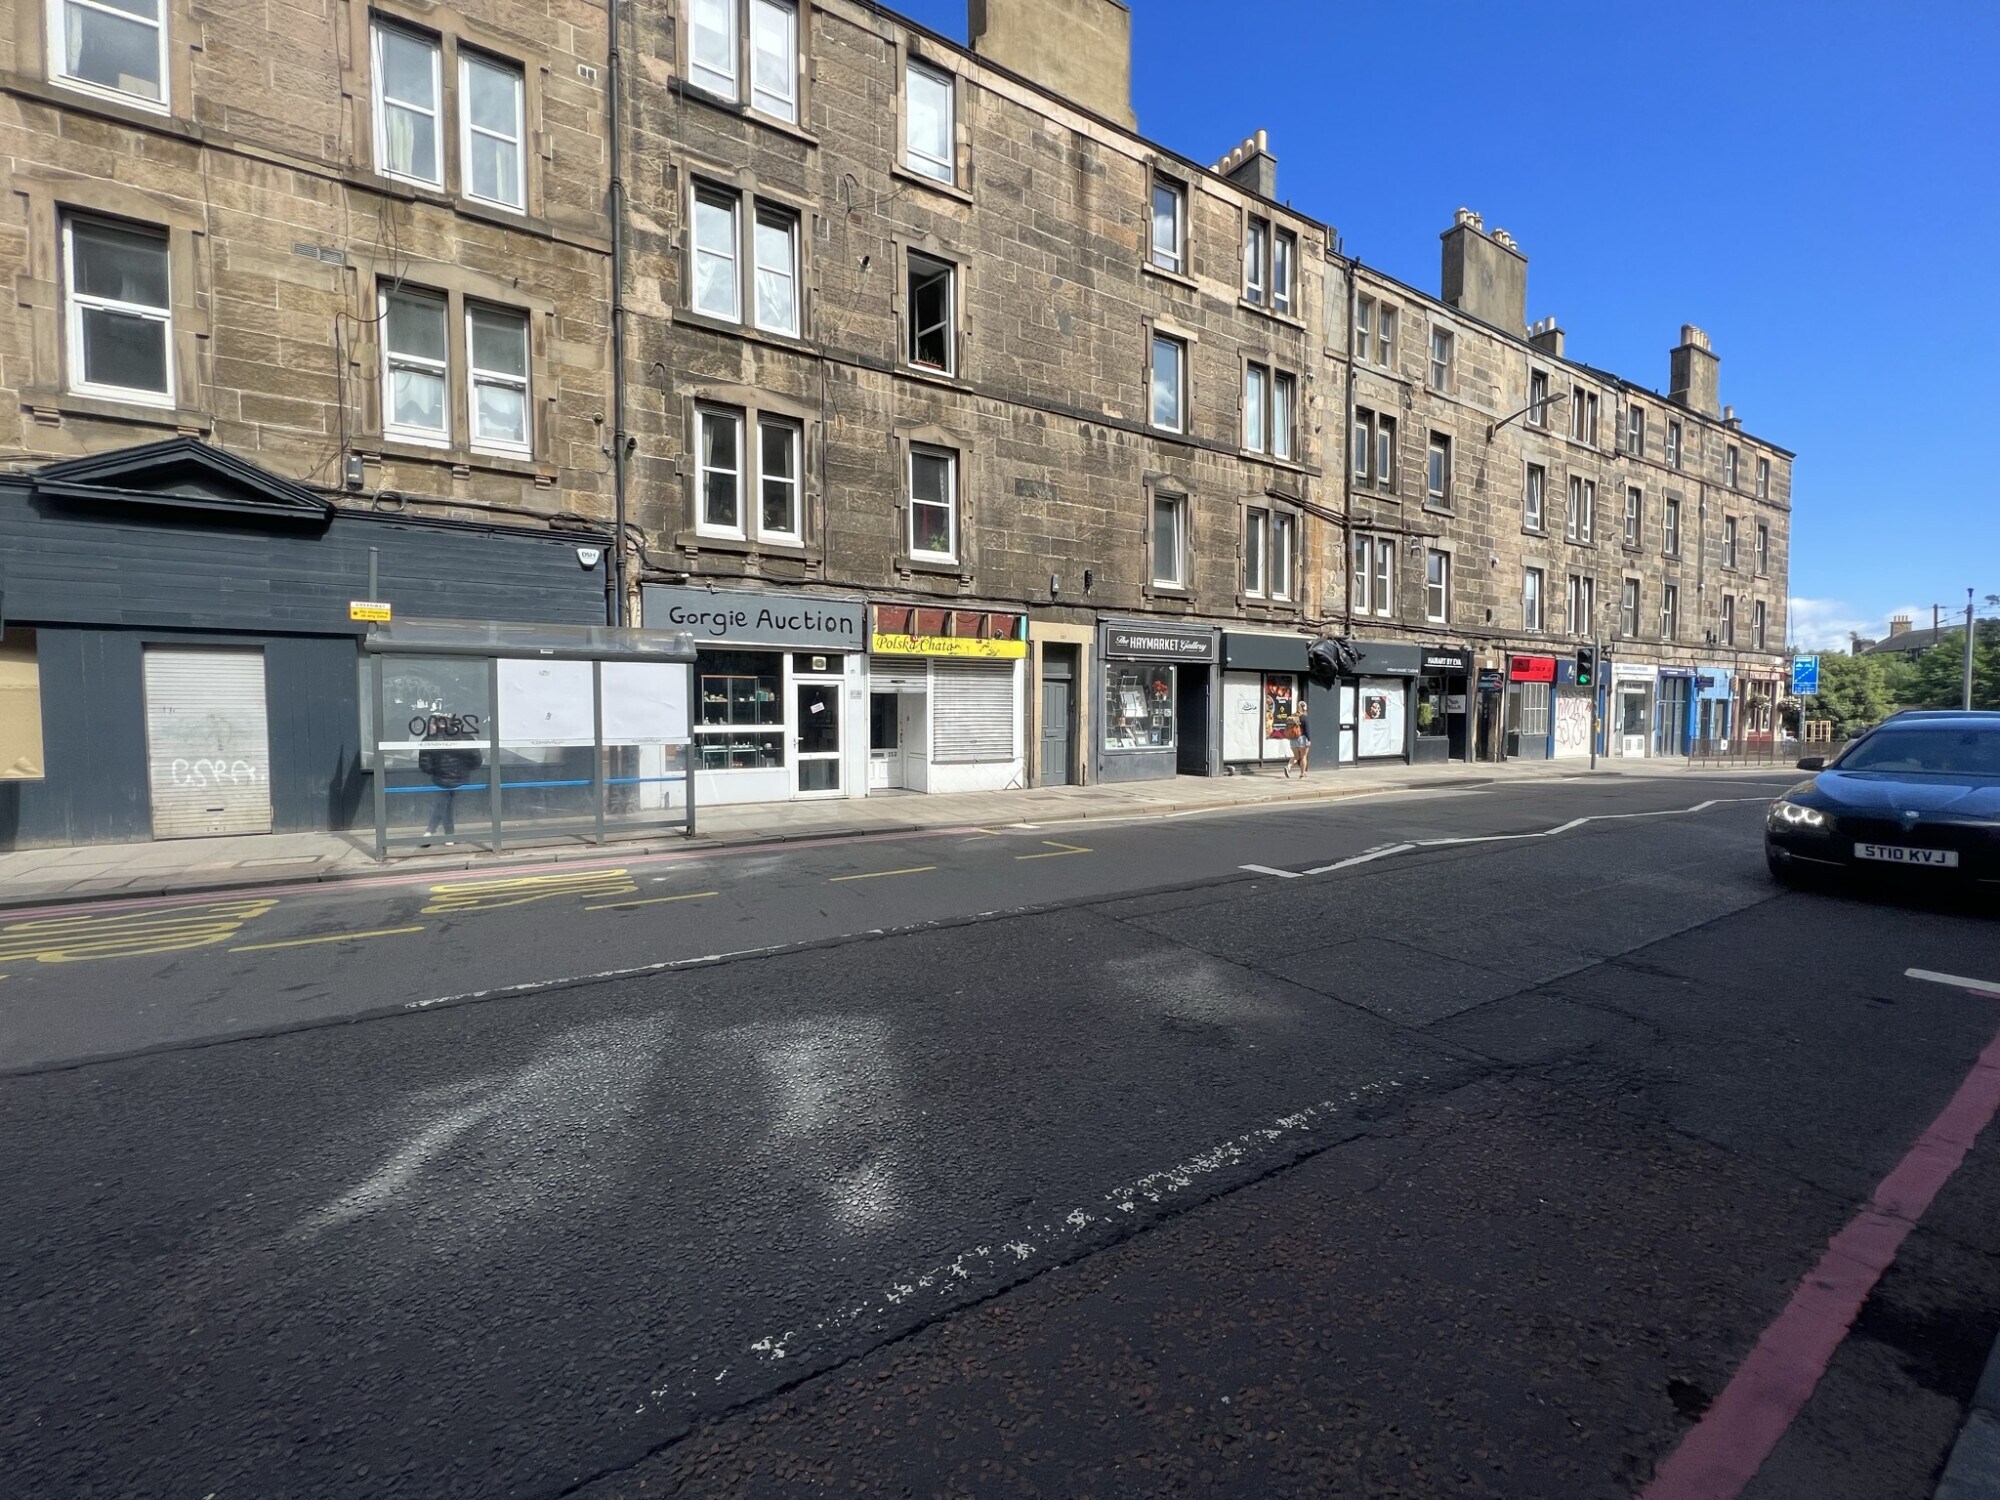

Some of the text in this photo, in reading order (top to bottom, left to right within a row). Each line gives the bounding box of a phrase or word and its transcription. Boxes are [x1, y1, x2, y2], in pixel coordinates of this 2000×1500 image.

[669, 606, 853, 636] Gorgie Auction
[876, 635, 916, 652] Polska
[1115, 635, 1207, 653] The HAYMARKET Gallery
[1865, 845, 1946, 864] ST10 KVJ
